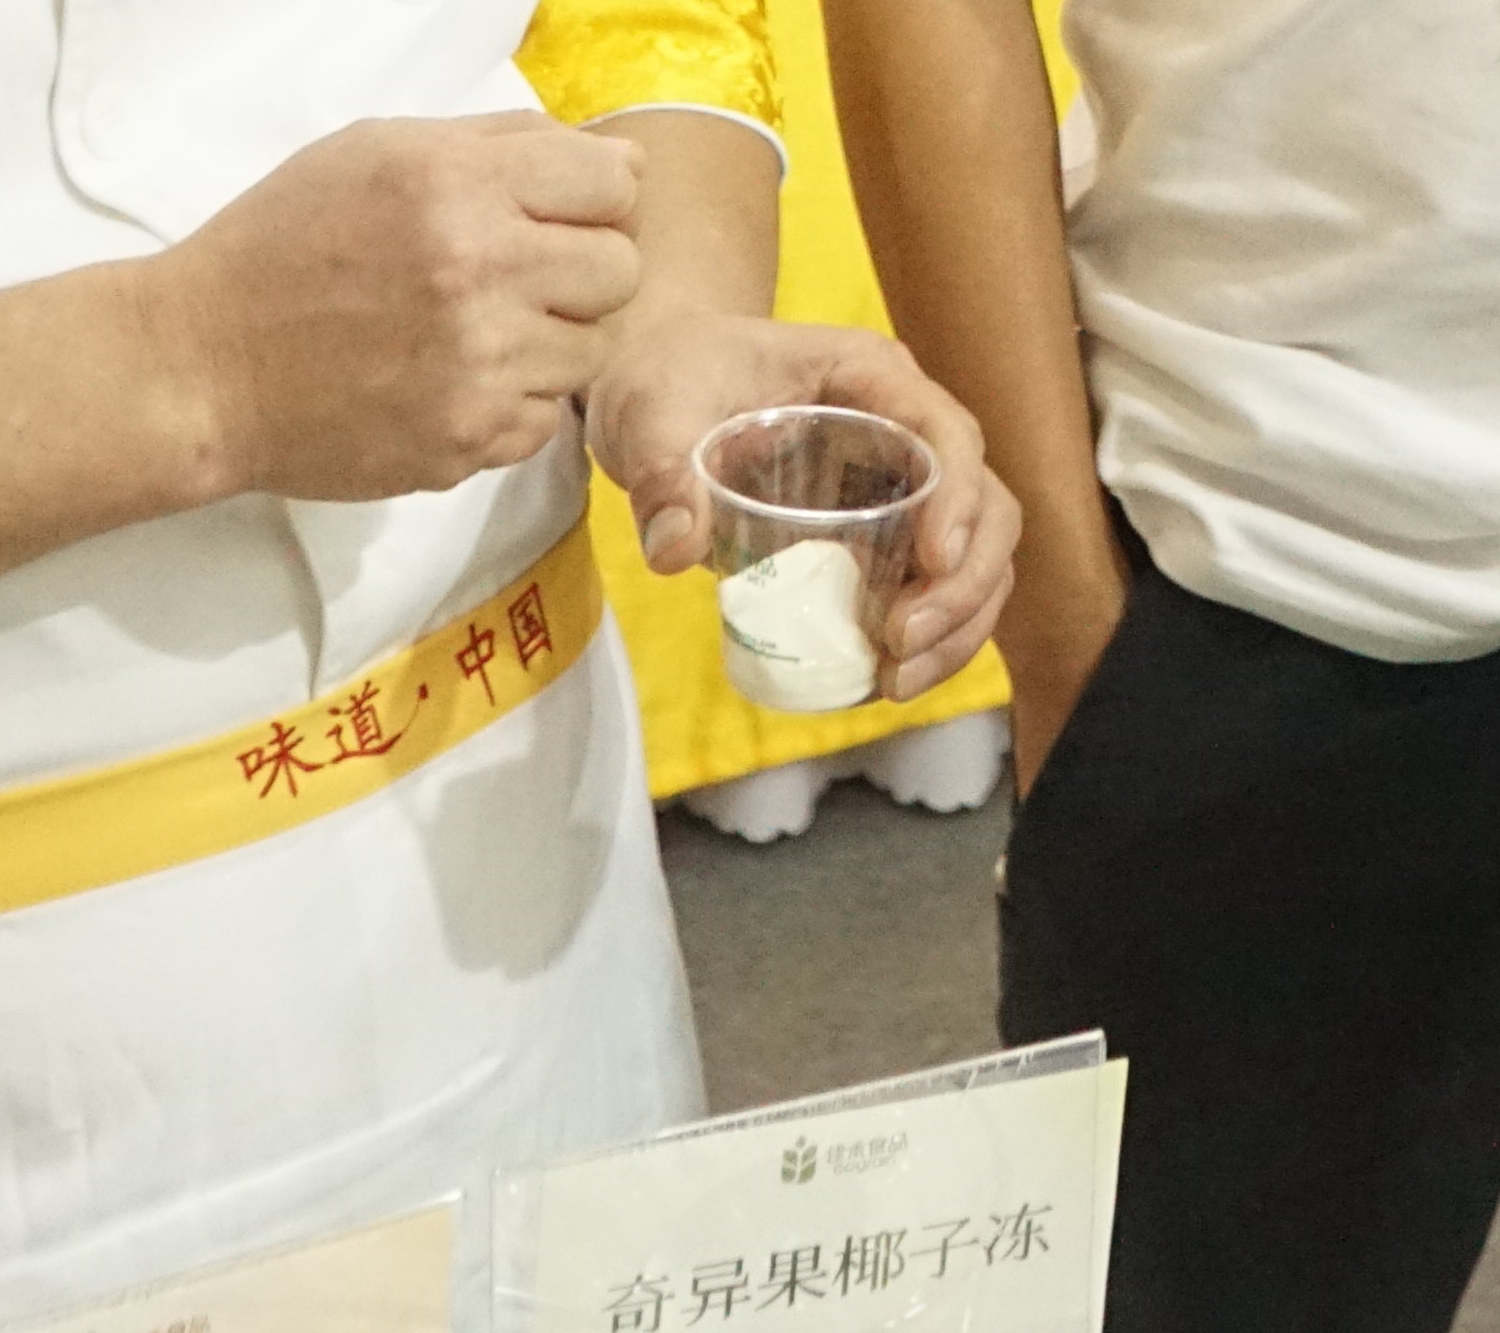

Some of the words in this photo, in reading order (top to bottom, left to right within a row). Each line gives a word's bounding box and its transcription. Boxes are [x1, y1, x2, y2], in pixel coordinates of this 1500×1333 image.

[826, 1130, 908, 1165] 佳禾食品
[600, 1201, 1054, 1333] 奇异果椰子冻
